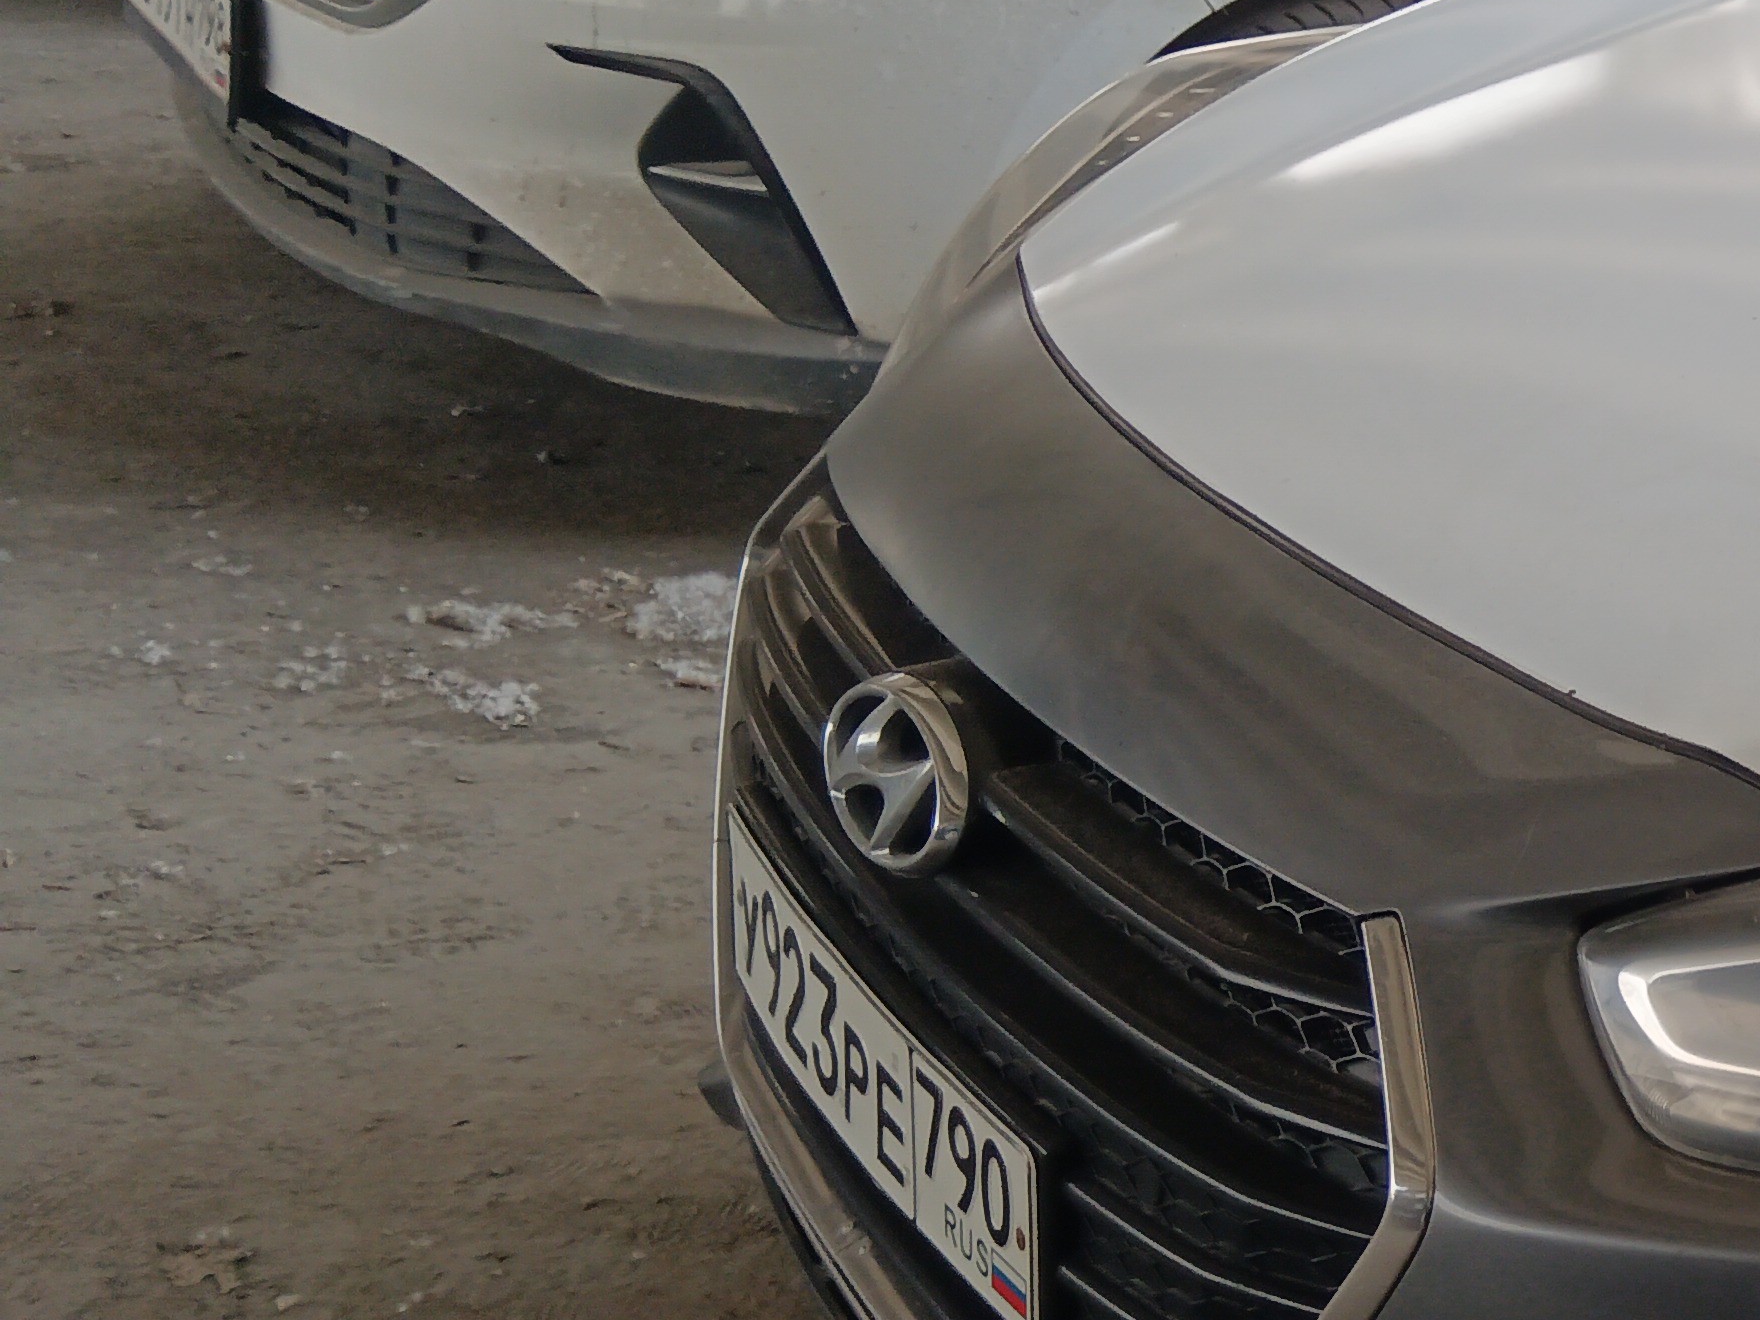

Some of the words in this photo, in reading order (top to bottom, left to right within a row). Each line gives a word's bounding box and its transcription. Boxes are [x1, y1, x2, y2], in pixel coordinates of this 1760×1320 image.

[738, 878, 905, 1187] У923РЕ
[916, 1066, 1011, 1247] 790
[944, 1204, 990, 1279] RUS
